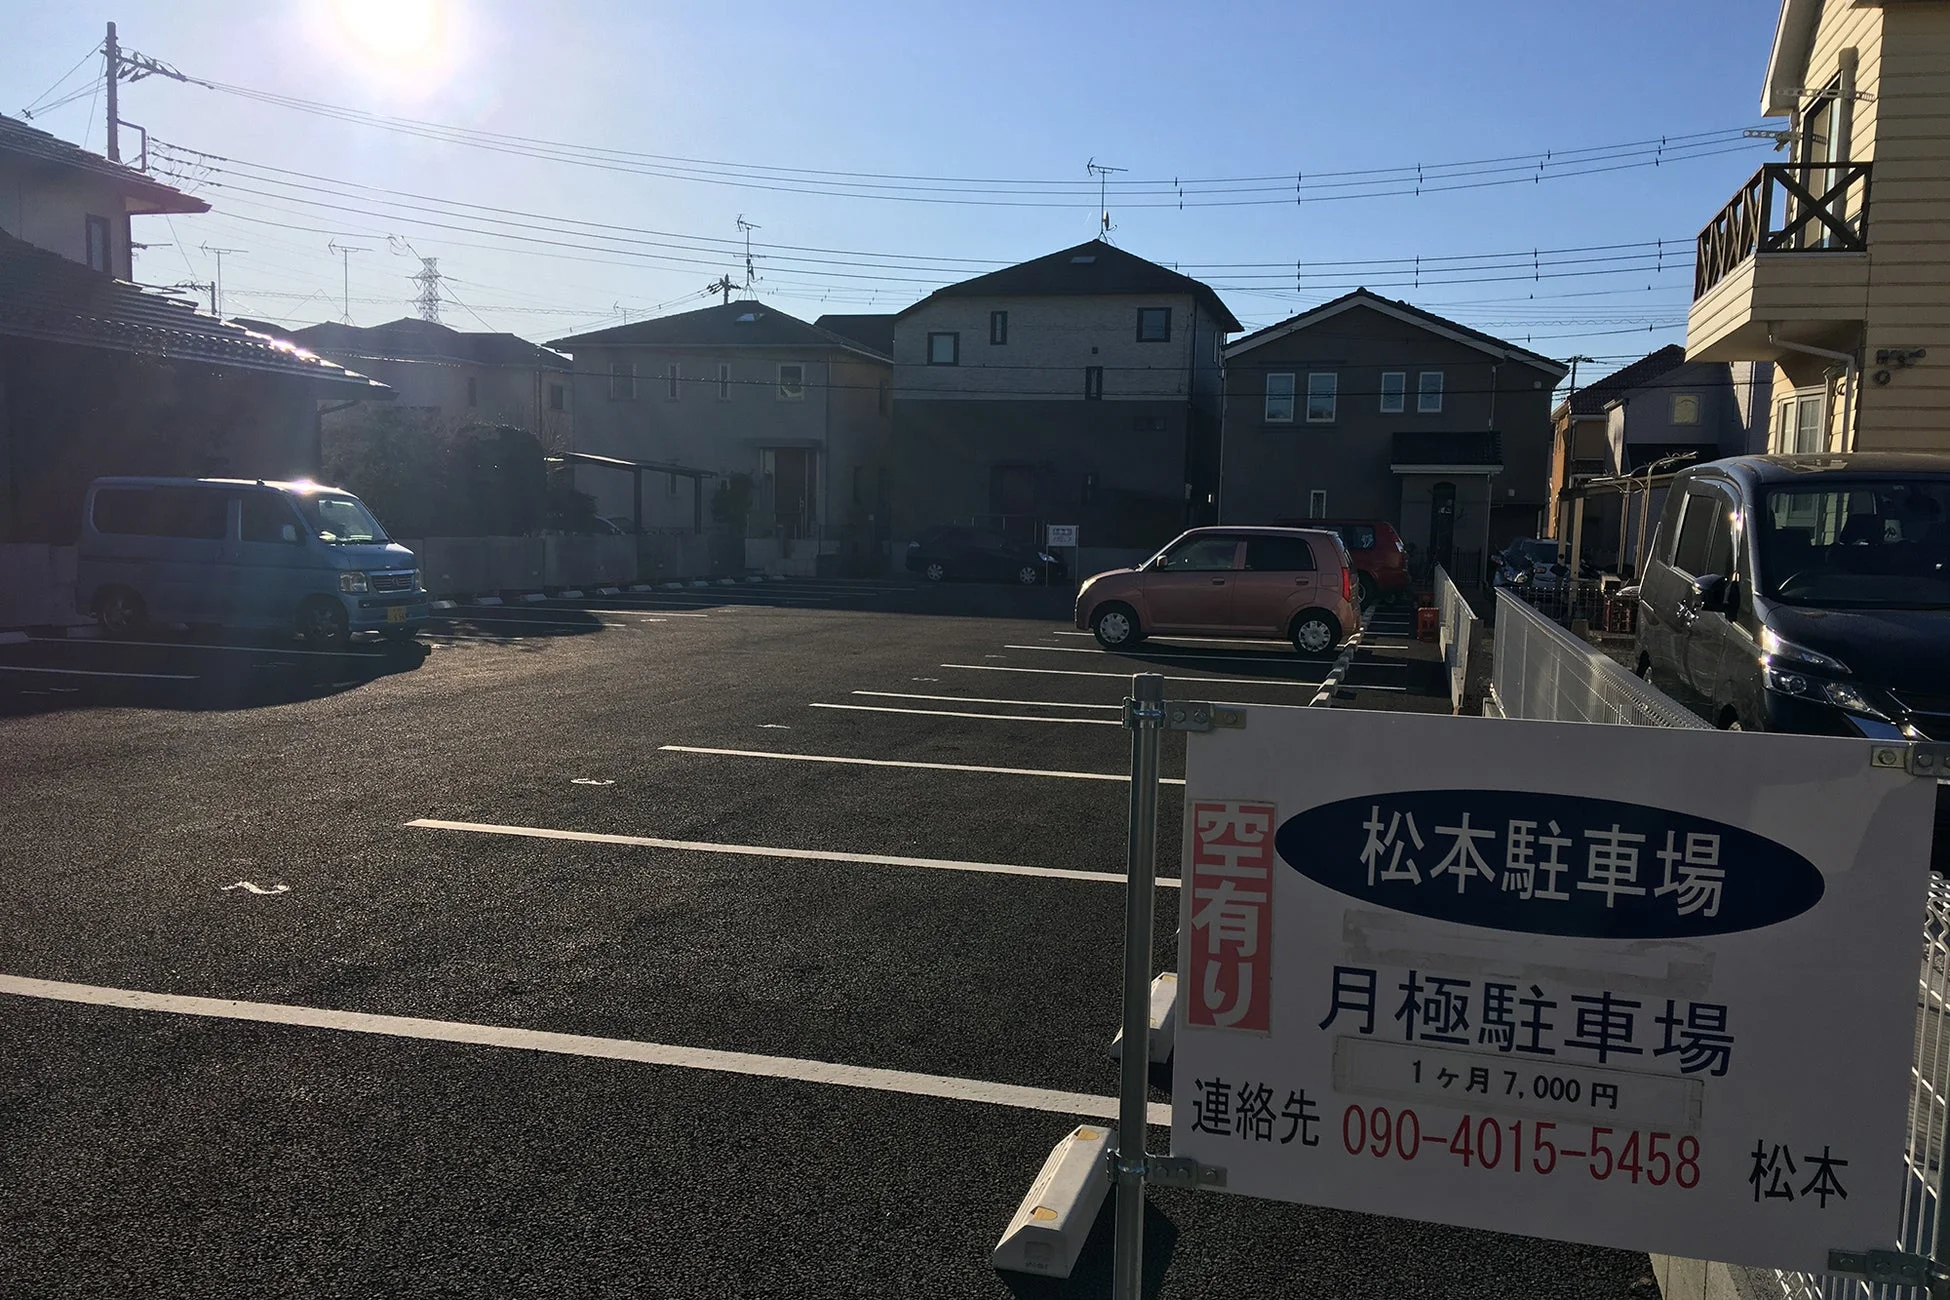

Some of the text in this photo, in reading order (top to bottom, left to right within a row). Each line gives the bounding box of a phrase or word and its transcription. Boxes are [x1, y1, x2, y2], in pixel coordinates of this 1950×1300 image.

[1360, 805, 1727, 919] 松本駐車場
[1190, 802, 1269, 1029] 空有り
[1318, 965, 1735, 1077] 月極駐車場
[1190, 1077, 1320, 1147] 連絡先
[1343, 1105, 1701, 1190] 090-4015-5458
[1748, 1139, 1849, 1209] 松本
